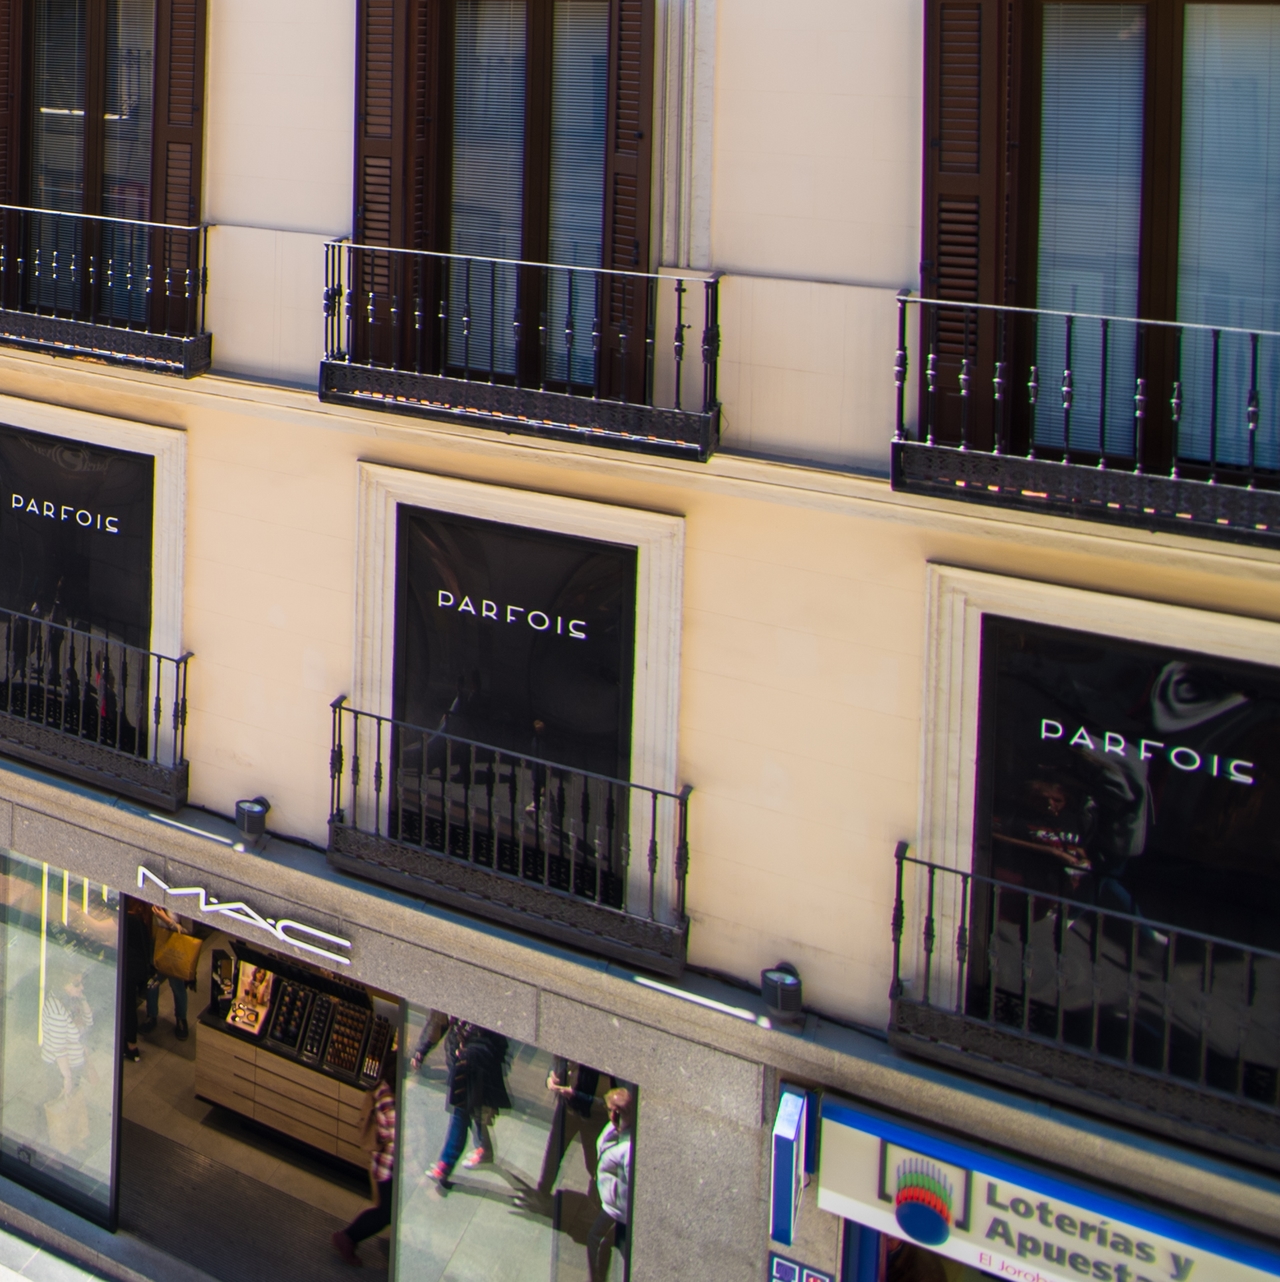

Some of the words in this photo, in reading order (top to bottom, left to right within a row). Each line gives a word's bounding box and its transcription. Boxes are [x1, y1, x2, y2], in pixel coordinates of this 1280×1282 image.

[11, 493, 120, 534] PARFOIS
[438, 589, 588, 640] PARFOIS
[1041, 718, 1254, 785] PARFOIS
[986, 1181, 1156, 1264] Loterías
[1169, 1252, 1195, 1282] y
[979, 1251, 992, 1267] El
